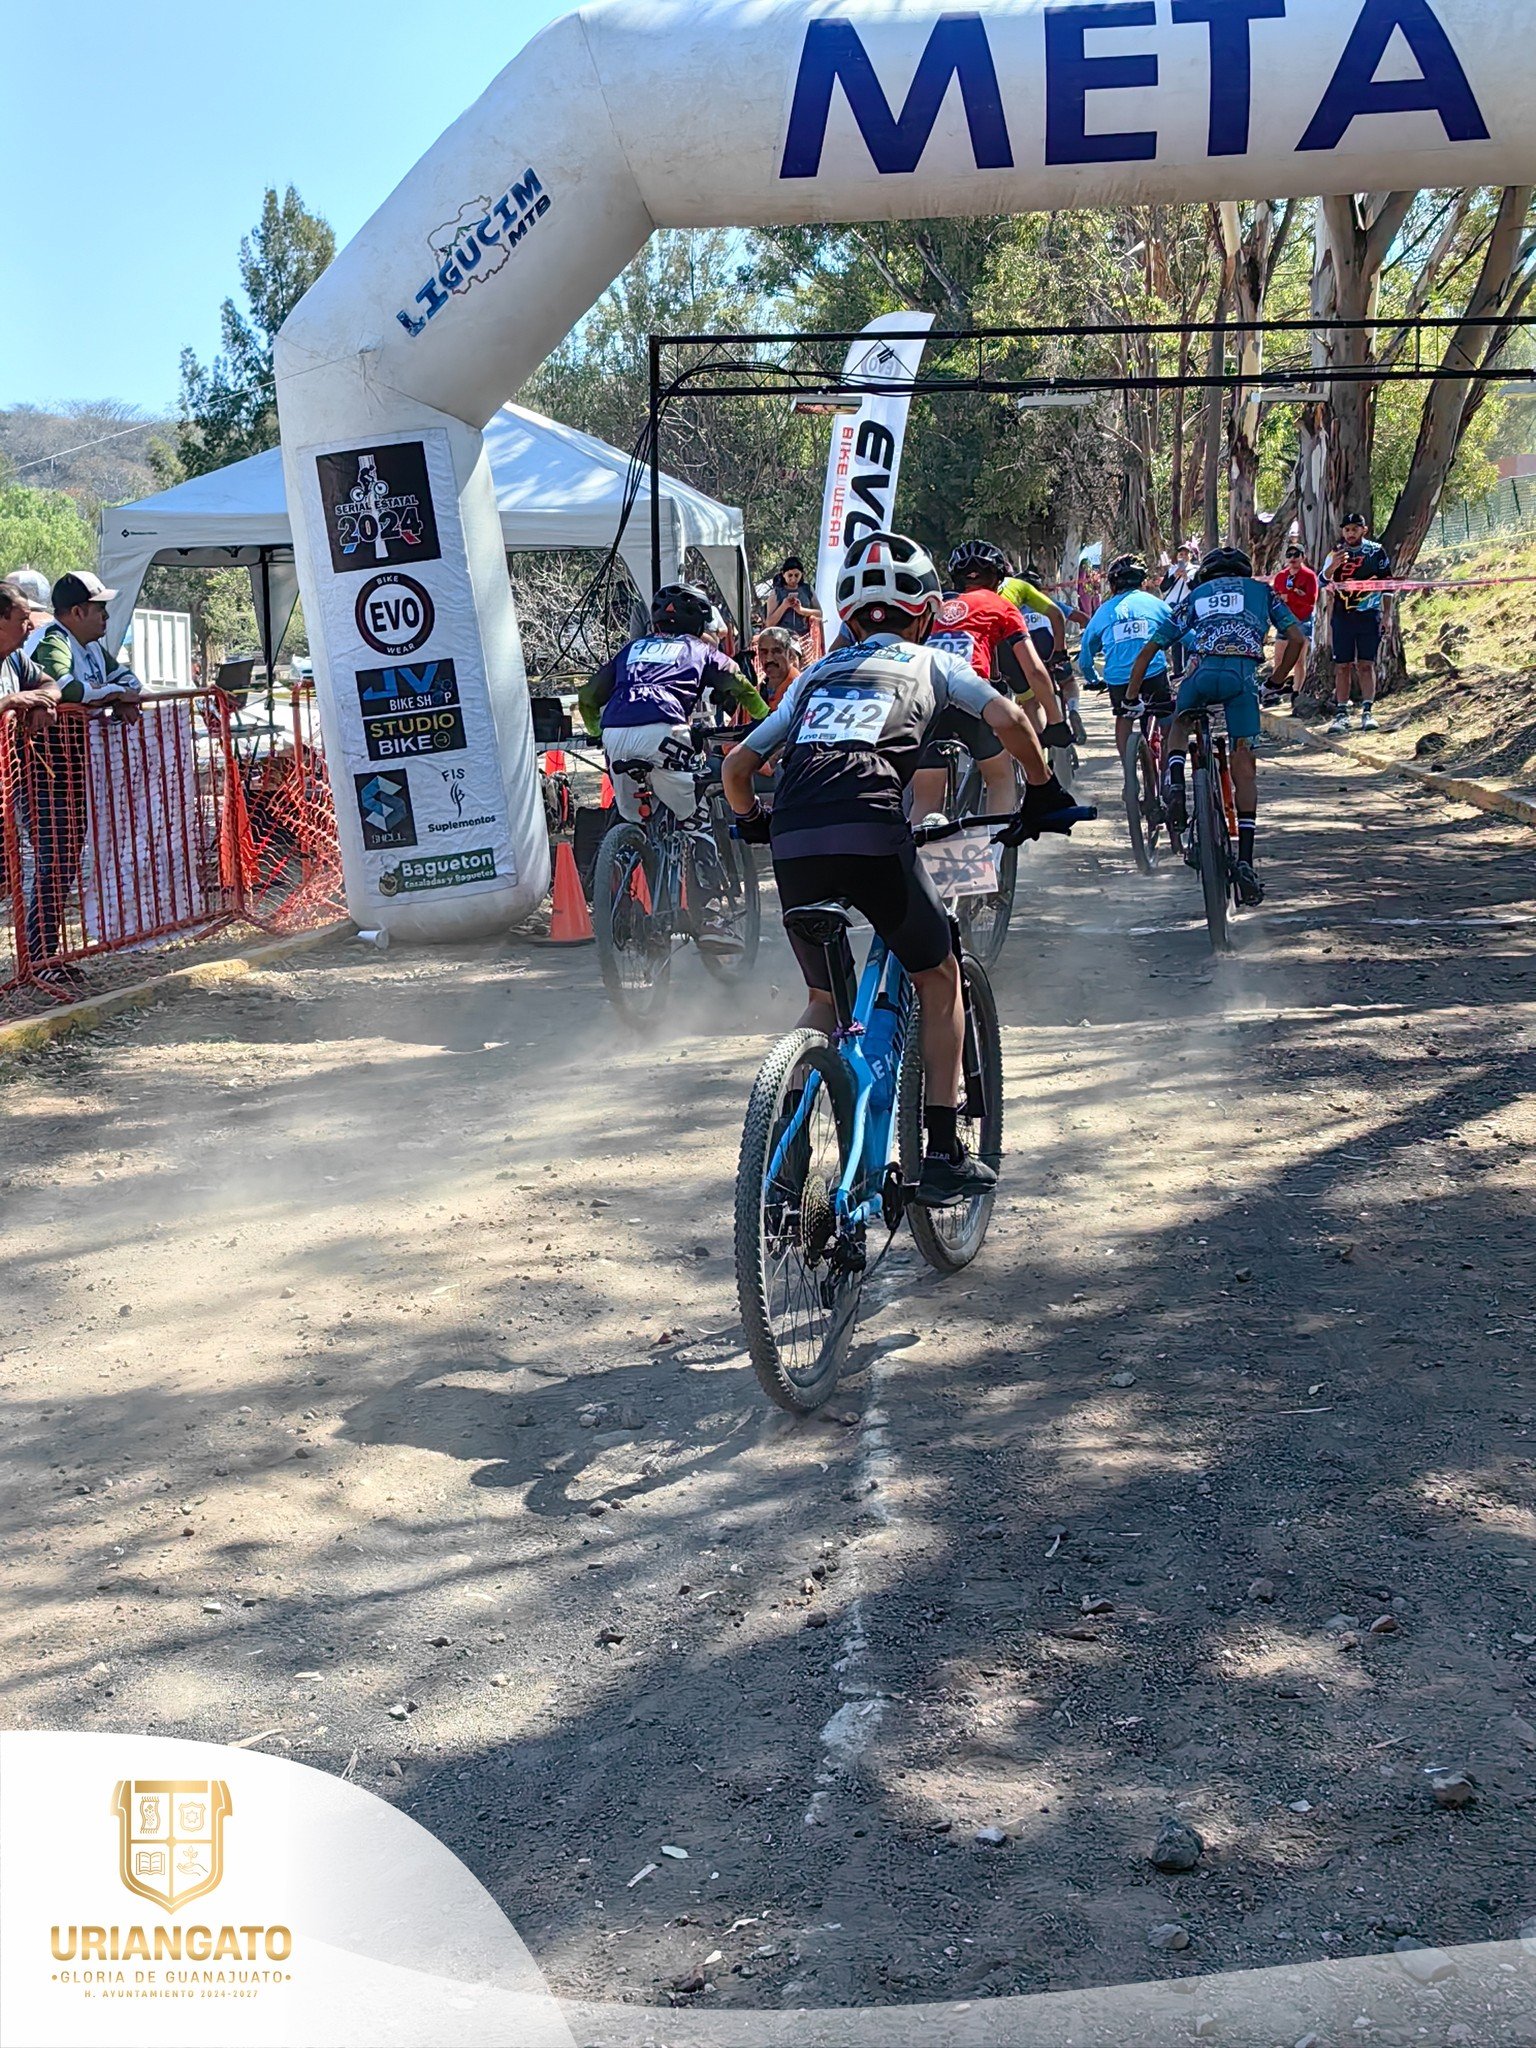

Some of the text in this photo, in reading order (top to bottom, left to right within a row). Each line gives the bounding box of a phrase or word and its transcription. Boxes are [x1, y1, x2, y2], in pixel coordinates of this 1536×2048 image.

[779, 0, 1491, 179] META
[508, 194, 551, 248] MTB
[396, 167, 543, 338] LIGUCIM
[828, 426, 854, 548] BIKE WEAR
[335, 495, 419, 516] SERIAL ESTATAL
[338, 507, 423, 547] 2024
[376, 575, 399, 586] BIKE
[1208, 594, 1230, 608] 99
[370, 597, 420, 633] EVO
[1123, 622, 1140, 634] 49
[386, 642, 415, 654] WEAR
[362, 663, 438, 700] JV
[389, 696, 415, 711] BIKE
[809, 702, 882, 730] 242
[370, 712, 455, 738] STUDIO
[441, 768, 465, 782] FIS
[427, 814, 496, 833] Suplementos
[401, 853, 492, 878] Bagueton
